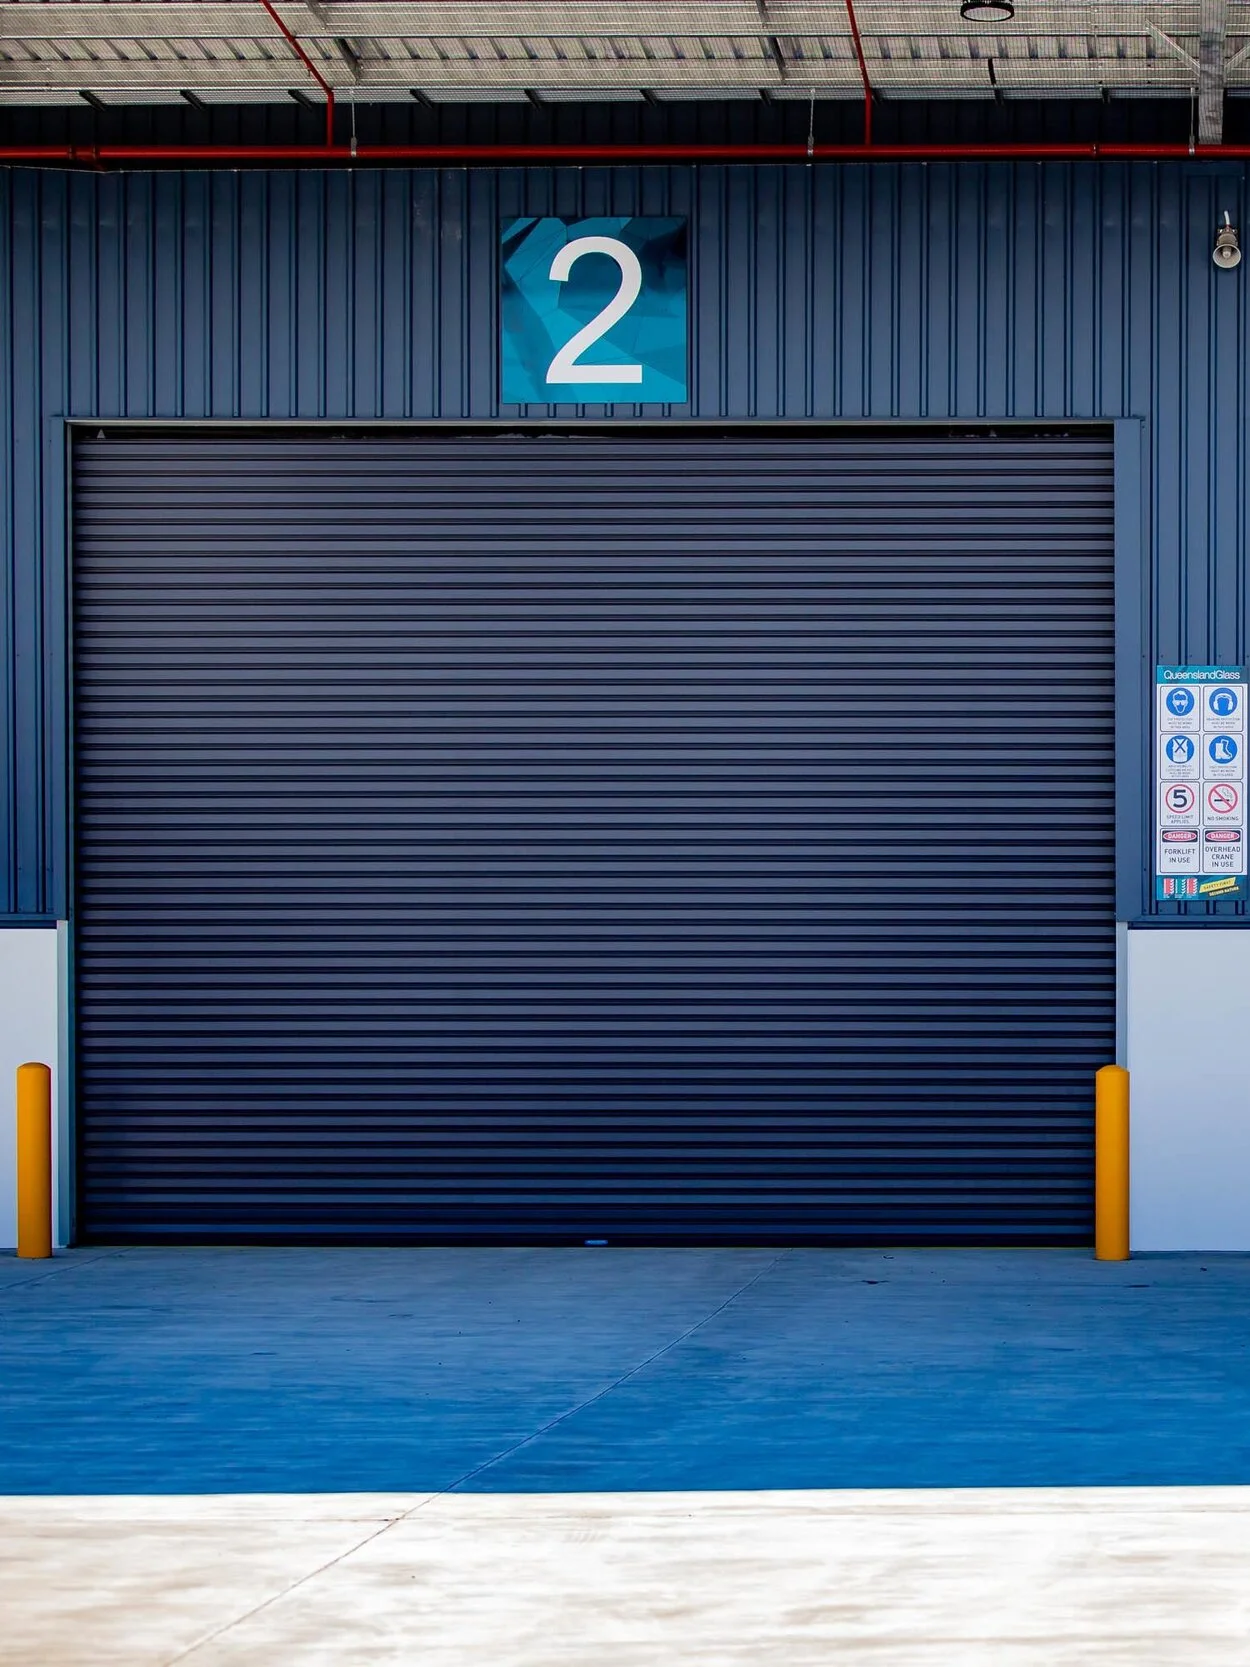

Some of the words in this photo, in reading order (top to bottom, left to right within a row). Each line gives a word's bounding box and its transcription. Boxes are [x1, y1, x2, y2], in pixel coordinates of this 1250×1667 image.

[546, 236, 643, 385] 2
[1163, 670, 1241, 680] QueenslandGlass
[1173, 789, 1188, 808] 5
